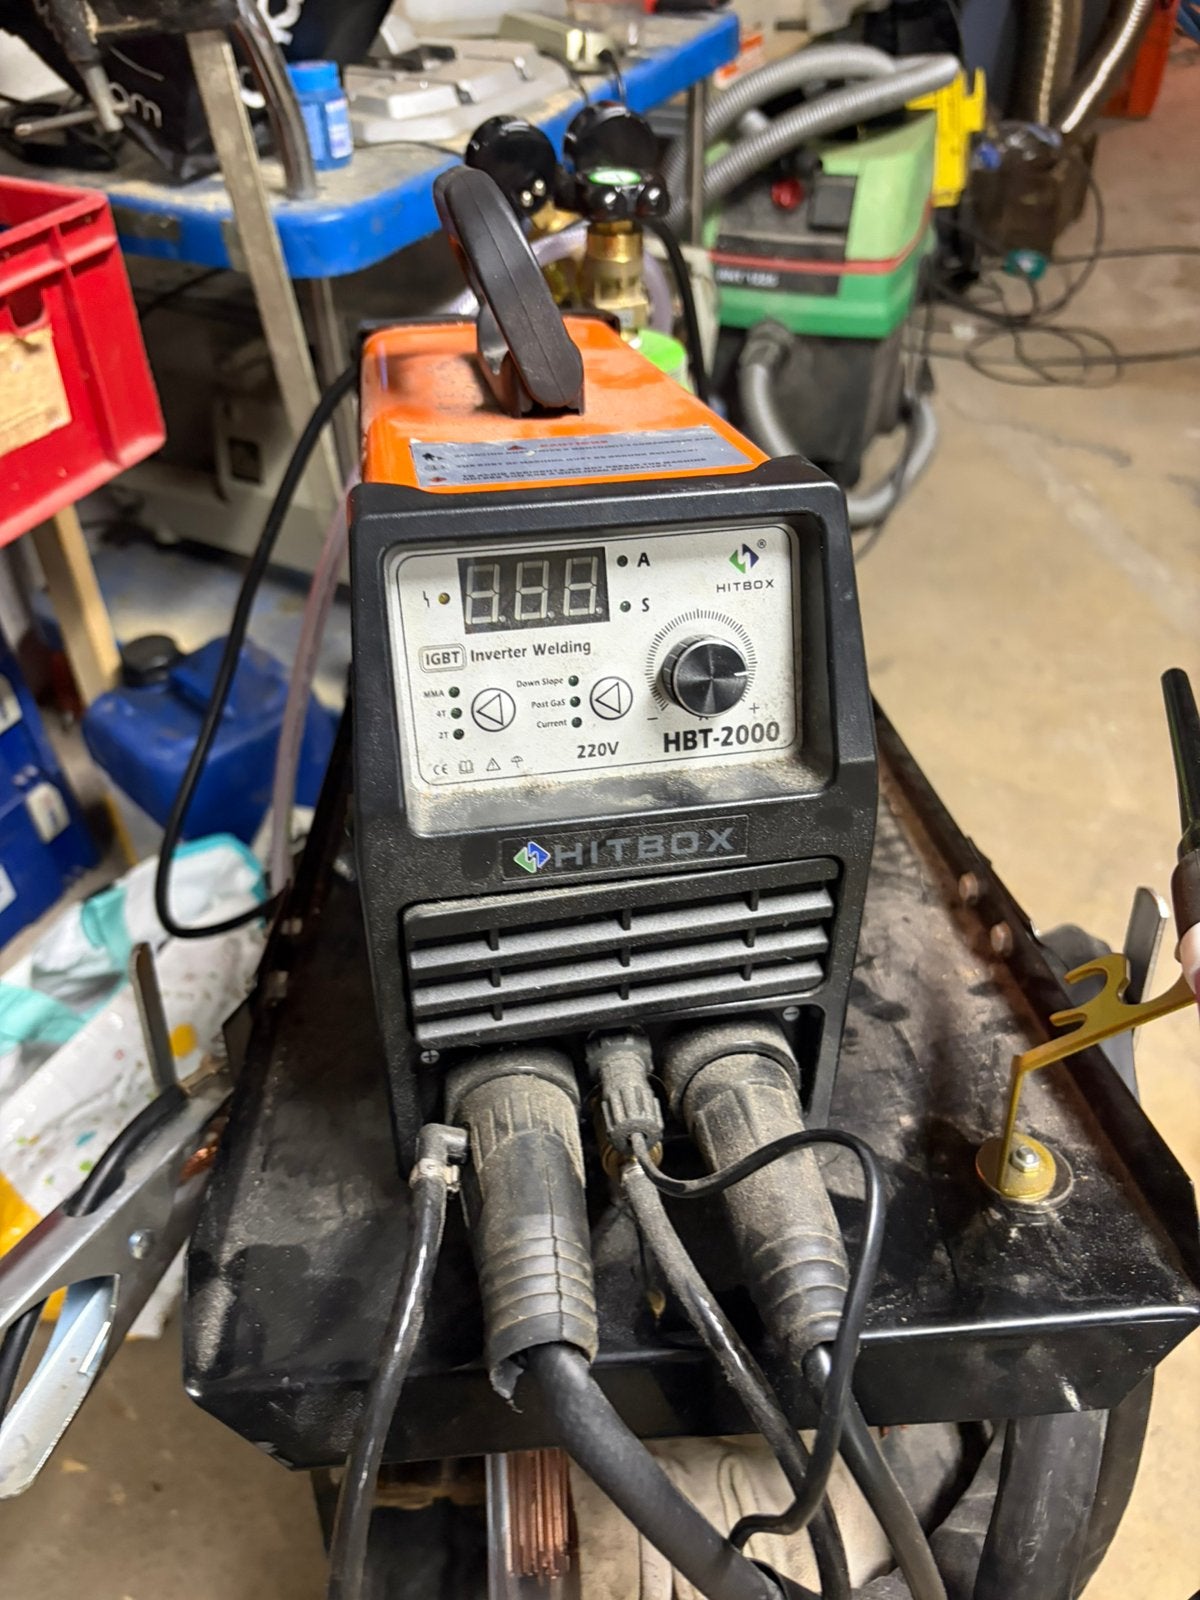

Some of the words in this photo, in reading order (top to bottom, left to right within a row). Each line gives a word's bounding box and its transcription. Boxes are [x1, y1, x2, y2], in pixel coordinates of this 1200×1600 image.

[637, 552, 650, 567] A
[716, 579, 775, 593] HITBOX
[642, 597, 650, 612] S
[425, 650, 460, 666] IGBT
[471, 647, 527, 662] Inverter
[533, 641, 591, 656] Welding
[516, 680, 540, 688] Down
[541, 677, 564, 687] Slope
[531, 701, 549, 709] Post
[536, 719, 567, 729] Current
[663, 721, 781, 753] HBT-2000
[577, 741, 619, 759] 220V
[554, 827, 735, 868] HITBOX
